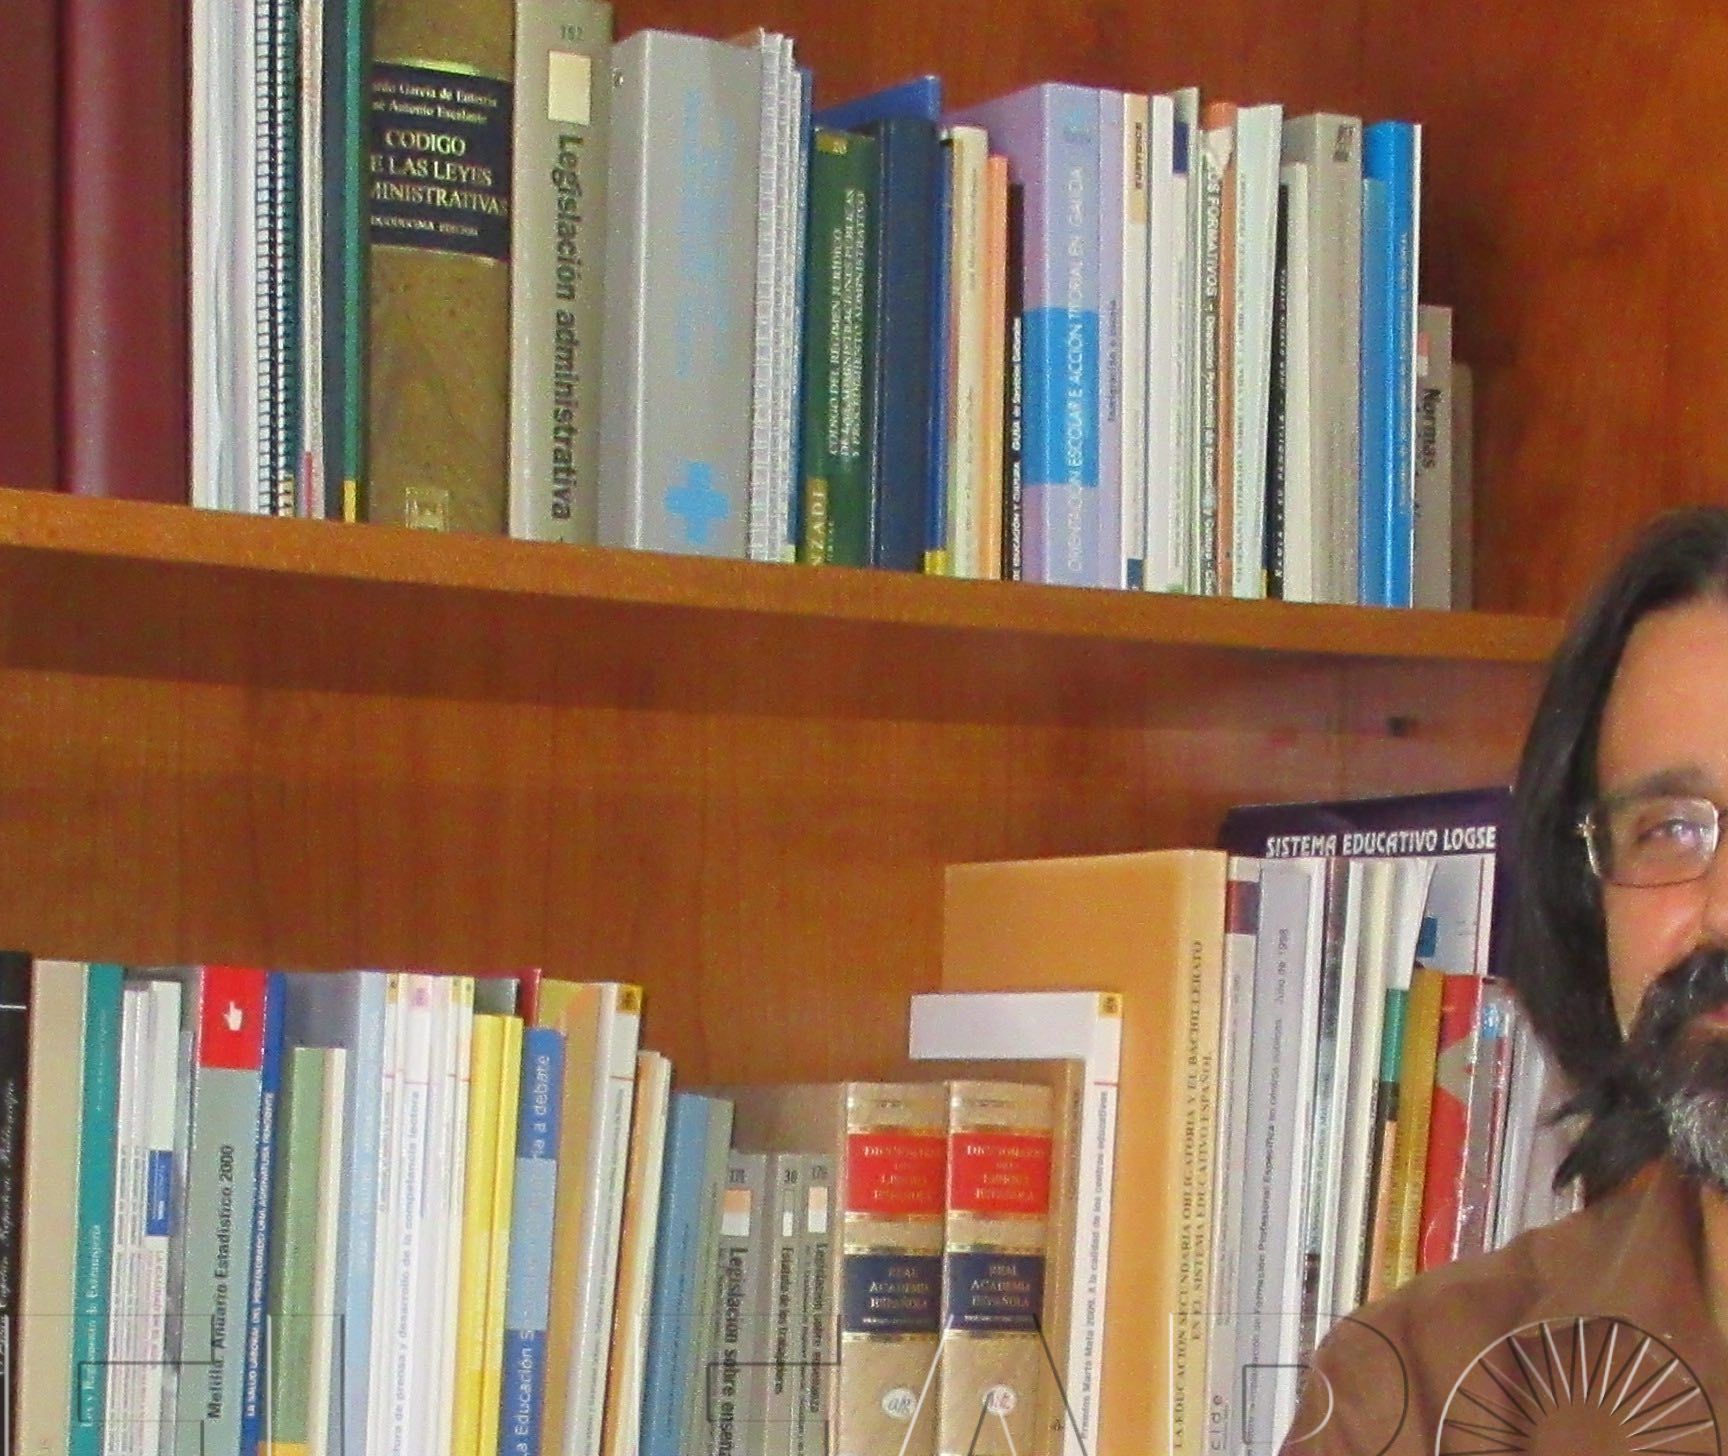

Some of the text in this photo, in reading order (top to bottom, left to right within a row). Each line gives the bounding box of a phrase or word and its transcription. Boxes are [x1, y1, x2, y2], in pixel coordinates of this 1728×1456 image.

[385, 130, 466, 157] CODIGO
[389, 156, 492, 187] LAS LEYES
[551, 134, 585, 521] Legislación administrativa
[1265, 825, 1497, 859] SISTEMA EDUCATIVO LOGSE
[1188, 939, 1204, 1067] BACHILLERATO
[533, 1054, 551, 1115] debate
[1188, 1073, 1199, 1090] EL
[409, 1090, 422, 1140] lectora
[1097, 1091, 1109, 1150] educativos
[218, 1145, 235, 1183] 2000
[1095, 1151, 1106, 1193] centros
[1182, 1109, 1197, 1219] OBLIGATORIA
[403, 1141, 421, 1231] competencia
[1093, 1195, 1104, 1211] los
[1191, 1052, 1213, 1341] EN EL SISTEMA EDUCATIVO ESPAÑOL
[402, 1233, 414, 1246] la
[1092, 1212, 1103, 1227] de
[401, 1250, 413, 1267] de
[1089, 1231, 1101, 1271] calidad
[1178, 1222, 1192, 1320] SECUNDARIA
[211, 1284, 227, 1350] Anuario
[397, 1270, 412, 1339] desarrollo
[1083, 1330, 1094, 1358] Mata
[394, 1354, 410, 1401] prensa
[512, 1347, 534, 1437] Educación
[1081, 1359, 1093, 1393] Marta
[393, 1405, 405, 1422] de
[1174, 1430, 1185, 1448] LA
